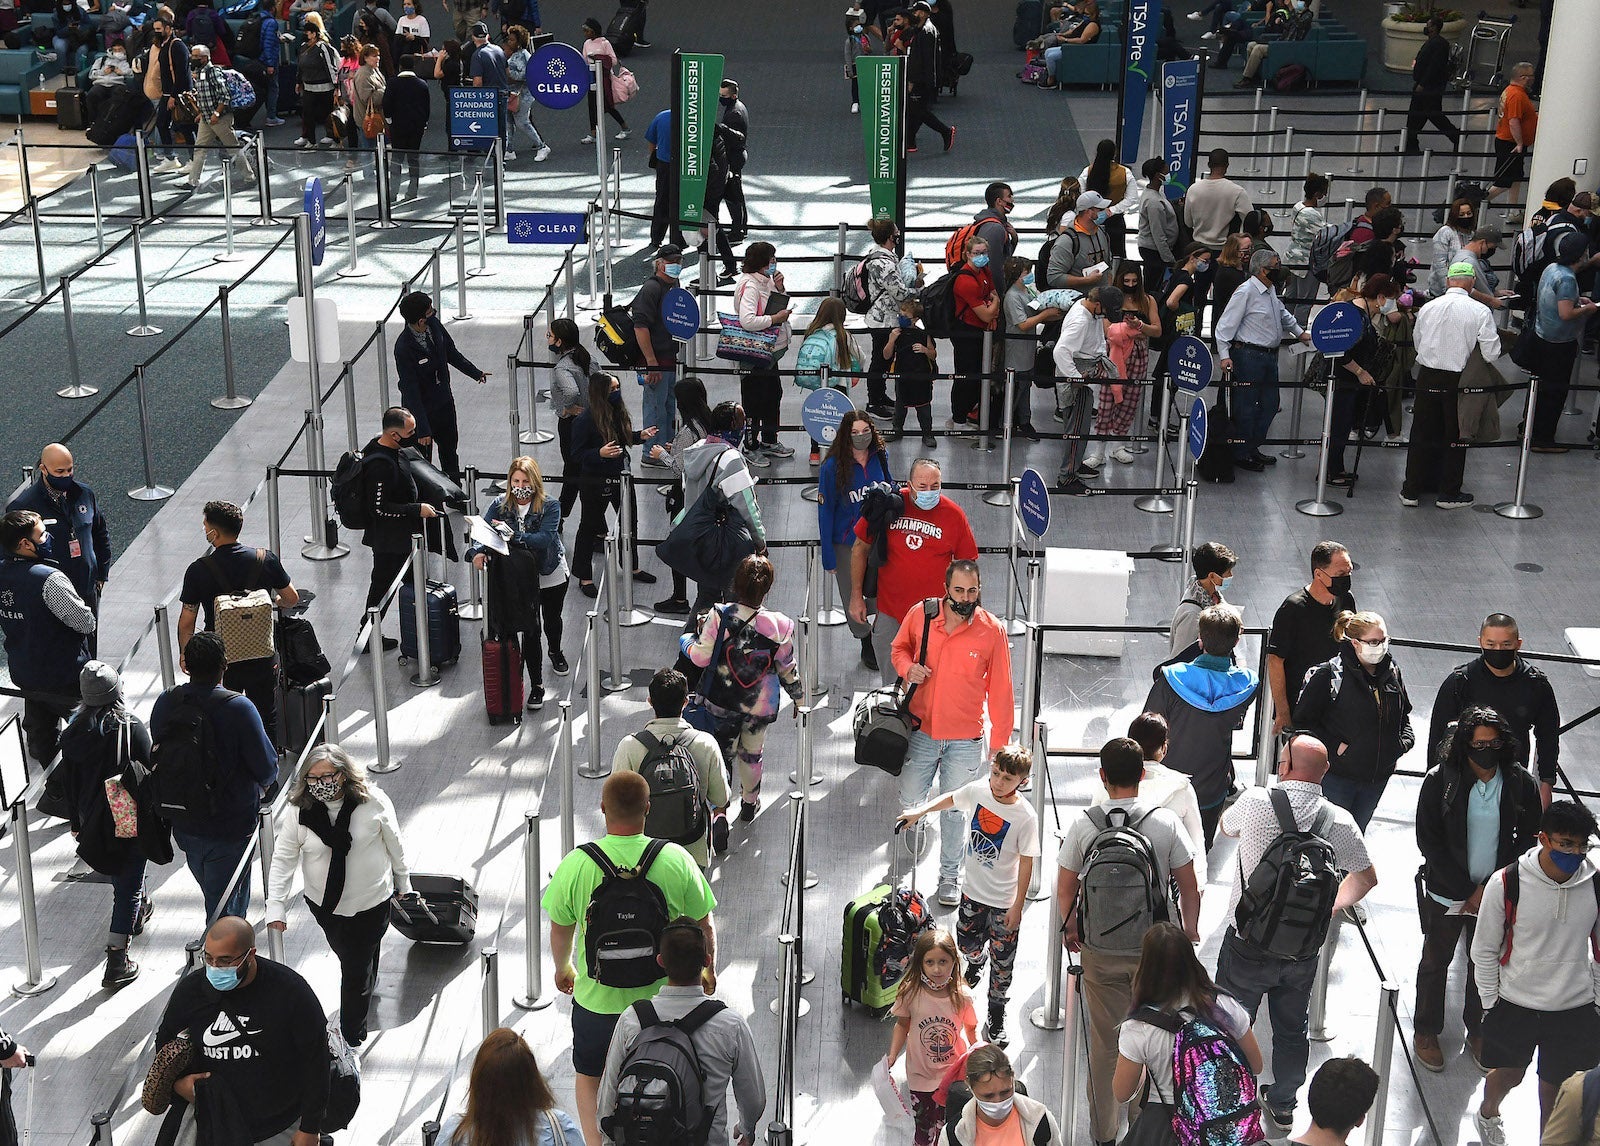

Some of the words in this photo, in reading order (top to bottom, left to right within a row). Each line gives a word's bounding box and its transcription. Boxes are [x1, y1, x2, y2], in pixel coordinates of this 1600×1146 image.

[1132, 2, 1149, 32] TSA
[1130, 35, 1145, 61] Pre
[537, 83, 579, 94] CLEAR
[687, 60, 699, 139] RESERVATION
[455, 101, 494, 109] STANDARD
[880, 63, 892, 138] RESERVATION
[454, 111, 495, 119] SCREENING
[1172, 99, 1188, 137] TSA
[686, 142, 698, 176] LANE
[879, 140, 890, 179] LANE
[1170, 140, 1185, 172] Pre
[537, 224, 577, 233] CLEAR
[1178, 358, 1202, 371] CLEAR
[1180, 370, 1197, 379] PLEASE
[889, 518, 943, 540] CHAMPIONS
[616, 912, 636, 921] Taylor
[203, 1046, 230, 1060] JUST
[232, 1044, 252, 1059] DO
